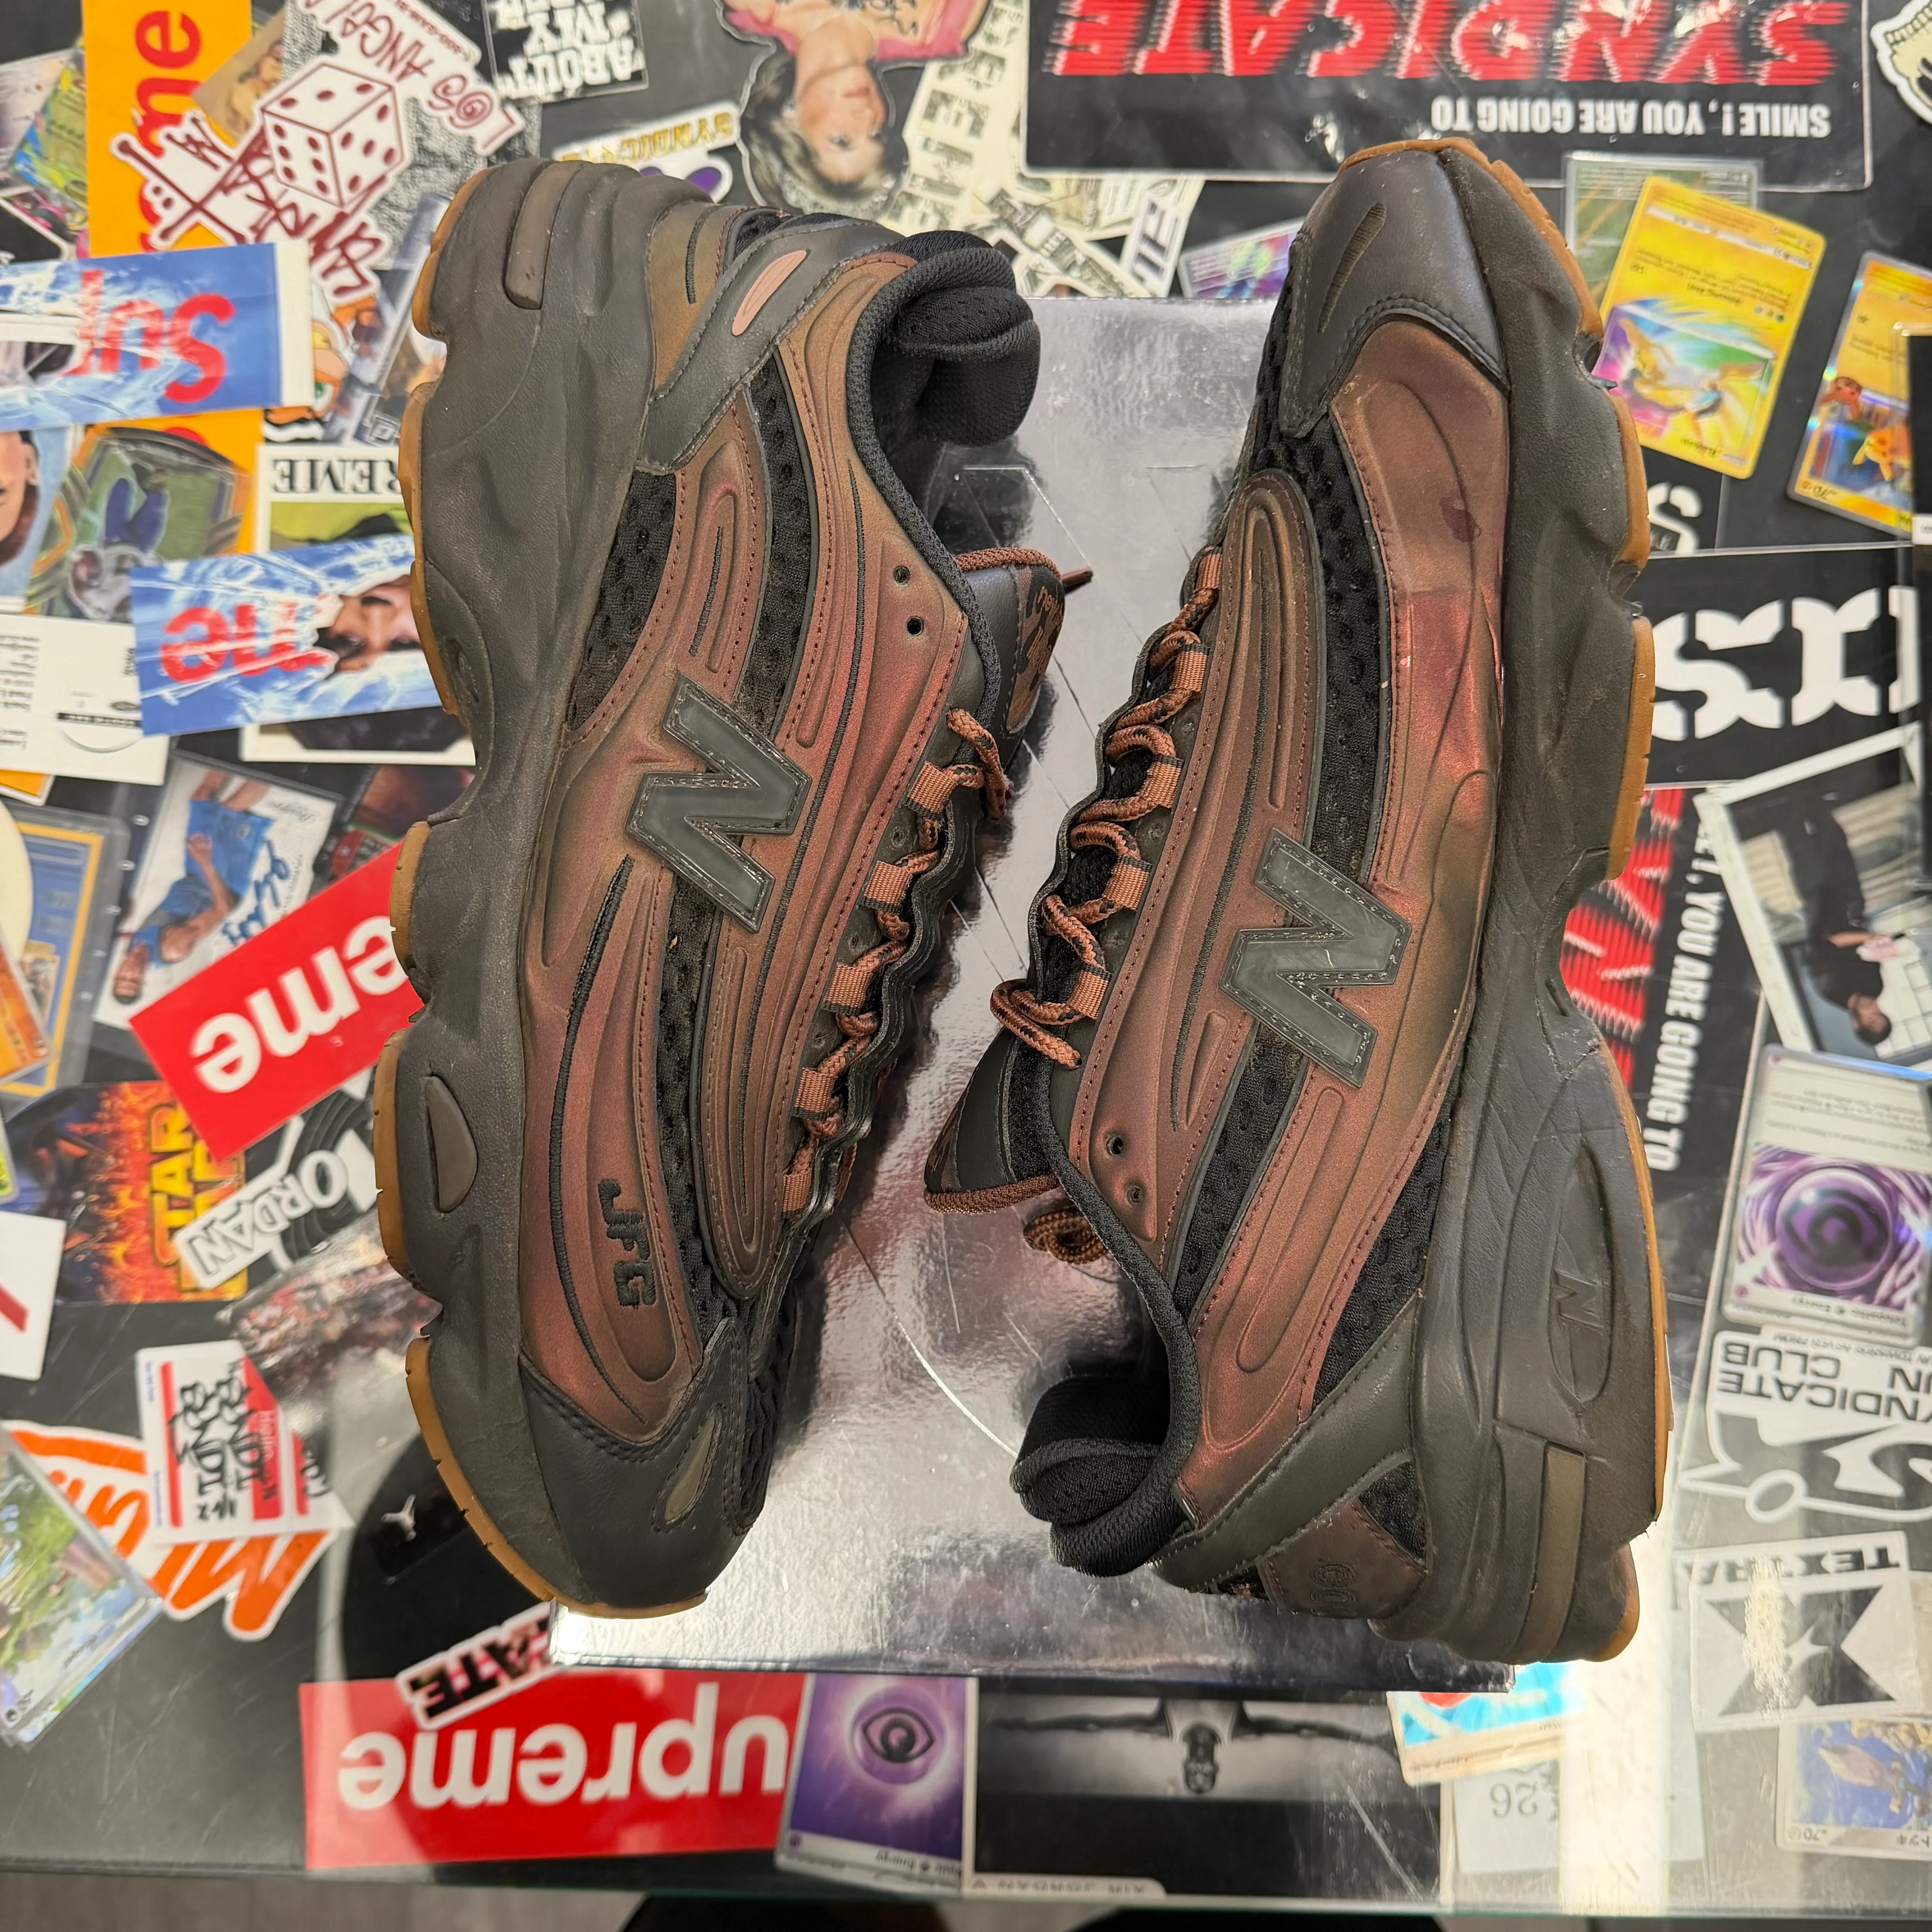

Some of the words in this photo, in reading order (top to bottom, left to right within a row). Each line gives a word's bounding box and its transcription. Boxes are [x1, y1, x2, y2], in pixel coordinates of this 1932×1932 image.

[509, 37, 634, 97] ABOUT
[1042, 0, 1851, 85] SYNDICATE
[1431, 95, 1474, 133] TO
[1477, 96, 1576, 133] GOING
[1580, 98, 1639, 135] ARE
[1642, 100, 1704, 137] YOU
[1676, 890, 1726, 957] YOU
[1665, 954, 1713, 1020] ARE
[1647, 1020, 1704, 1126] GOING
[1643, 1127, 1685, 1172] TO
[184, 1148, 350, 1276] ORDAN
[1725, 1341, 1841, 1380] CLUB
[337, 1682, 789, 1810] upreme
